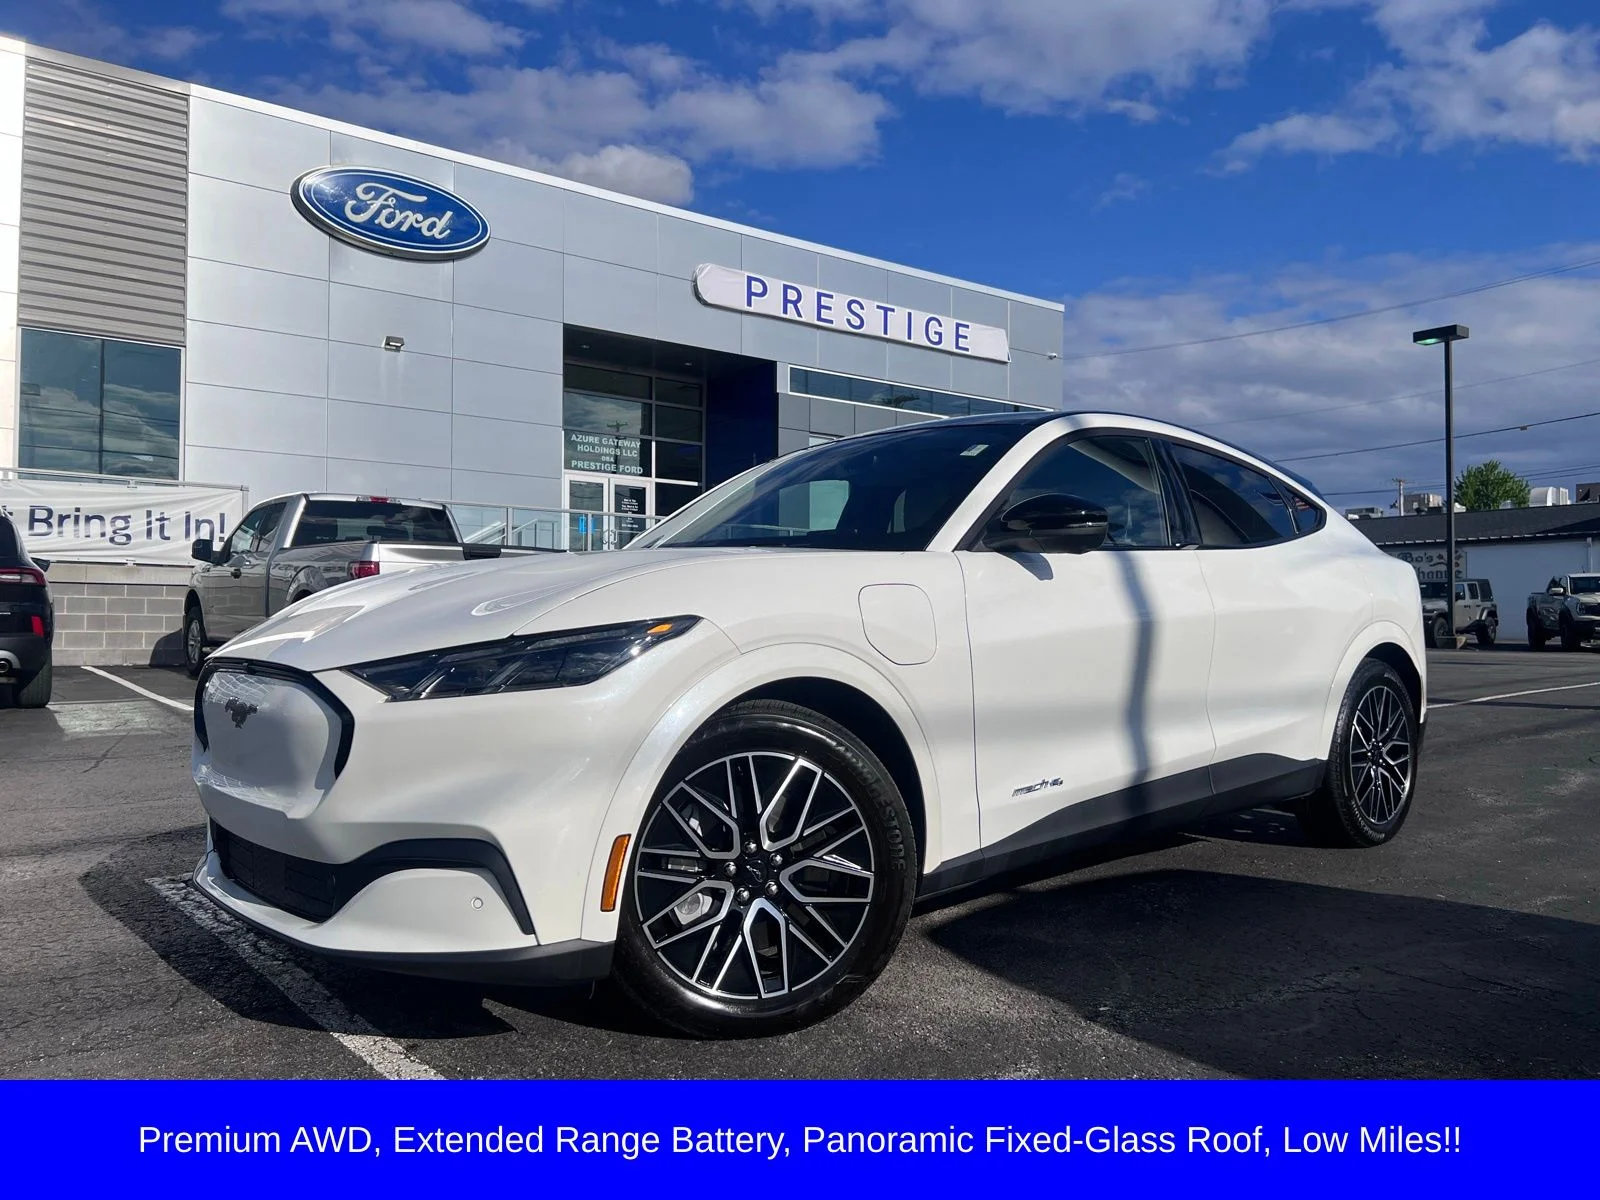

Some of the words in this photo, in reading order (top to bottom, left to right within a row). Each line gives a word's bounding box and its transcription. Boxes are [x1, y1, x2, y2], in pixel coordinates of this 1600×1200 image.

[344, 182, 453, 240] Ford
[745, 274, 971, 353] PRESTIGE
[571, 434, 600, 444] AZURE
[602, 437, 641, 449] GATEWAY
[577, 444, 621, 455] HOLDINGS
[622, 449, 638, 457] LLC
[571, 460, 617, 472] PRESTIGE
[619, 465, 644, 474] FORD
[28, 505, 132, 546] Bring
[146, 509, 171, 541] It
[185, 511, 226, 543] In!
